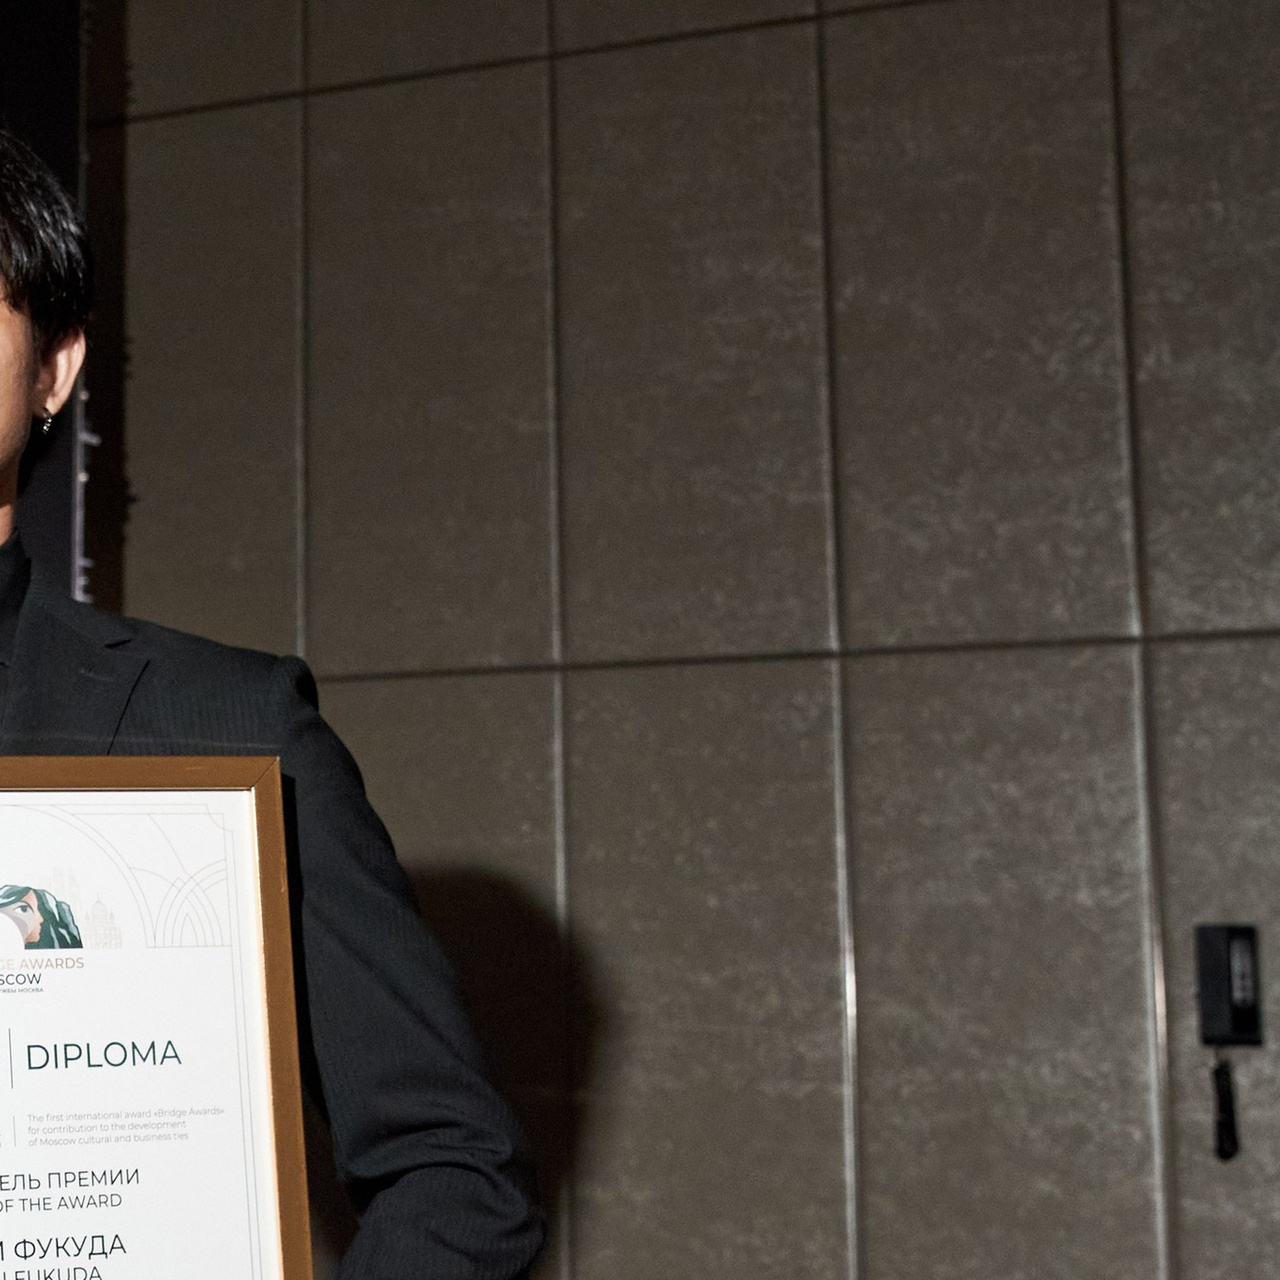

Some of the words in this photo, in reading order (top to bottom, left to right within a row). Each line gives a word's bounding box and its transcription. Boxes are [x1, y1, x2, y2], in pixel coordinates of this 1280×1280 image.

[19, 956, 84, 970] AWARDS
[26, 1039, 182, 1071] DIPLOMA
[28, 1113, 44, 1123] The
[45, 1112, 63, 1122] first
[65, 1110, 122, 1121] international
[124, 1109, 151, 1119] award
[27, 1125, 39, 1134] for
[41, 1123, 97, 1133] contribution
[99, 1122, 109, 1131] to
[110, 1121, 125, 1131] the
[127, 1119, 186, 1131] development
[28, 1137, 37, 1146] of
[39, 1136, 76, 1146] Moscow
[77, 1134, 112, 1144] cultural
[114, 1134, 131, 1143] and
[133, 1133, 171, 1142] business
[173, 1132, 188, 1141] ties
[47, 1168, 139, 1189] ПРЕМИИ
[19, 1197, 51, 1212] THE
[57, 1194, 122, 1210] AWARD
[14, 1234, 125, 1260] ФУКУДА
